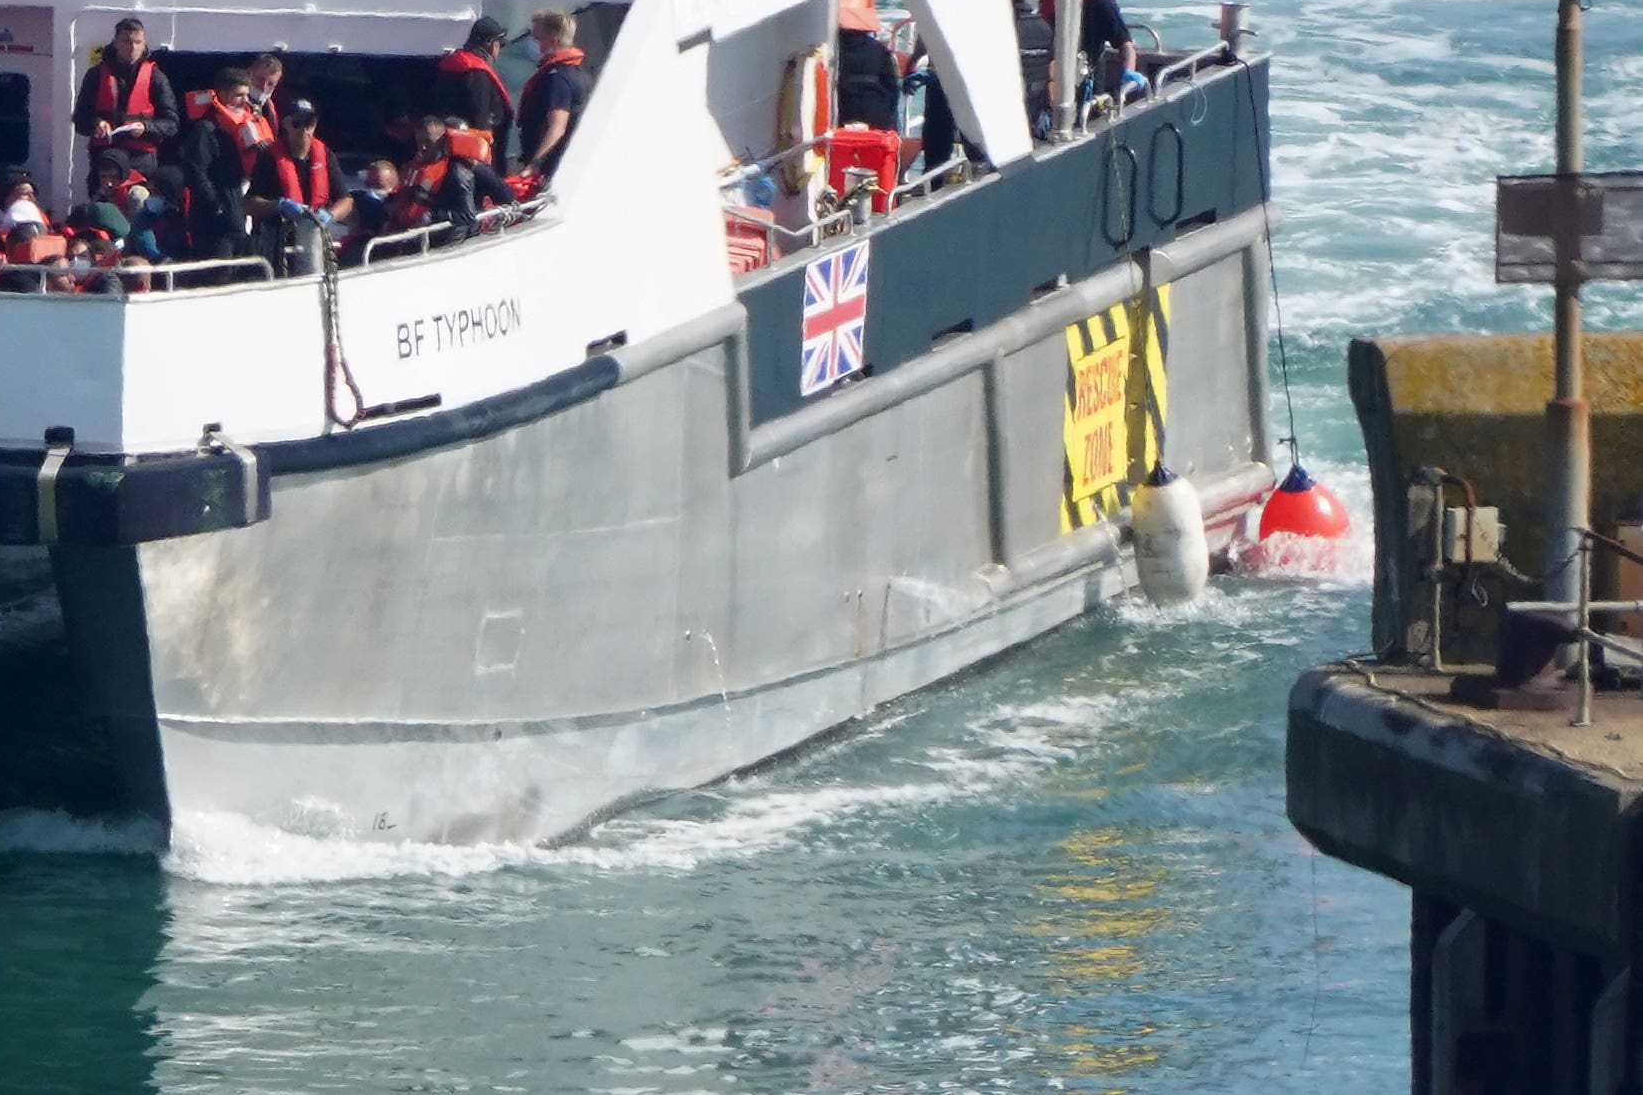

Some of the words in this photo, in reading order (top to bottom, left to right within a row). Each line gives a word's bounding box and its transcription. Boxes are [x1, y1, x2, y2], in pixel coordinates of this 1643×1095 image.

[397, 319, 425, 359] BF
[431, 297, 521, 352] TYPHOON
[1077, 349, 1122, 421] RESCUE
[1083, 421, 1114, 486] ZONE
